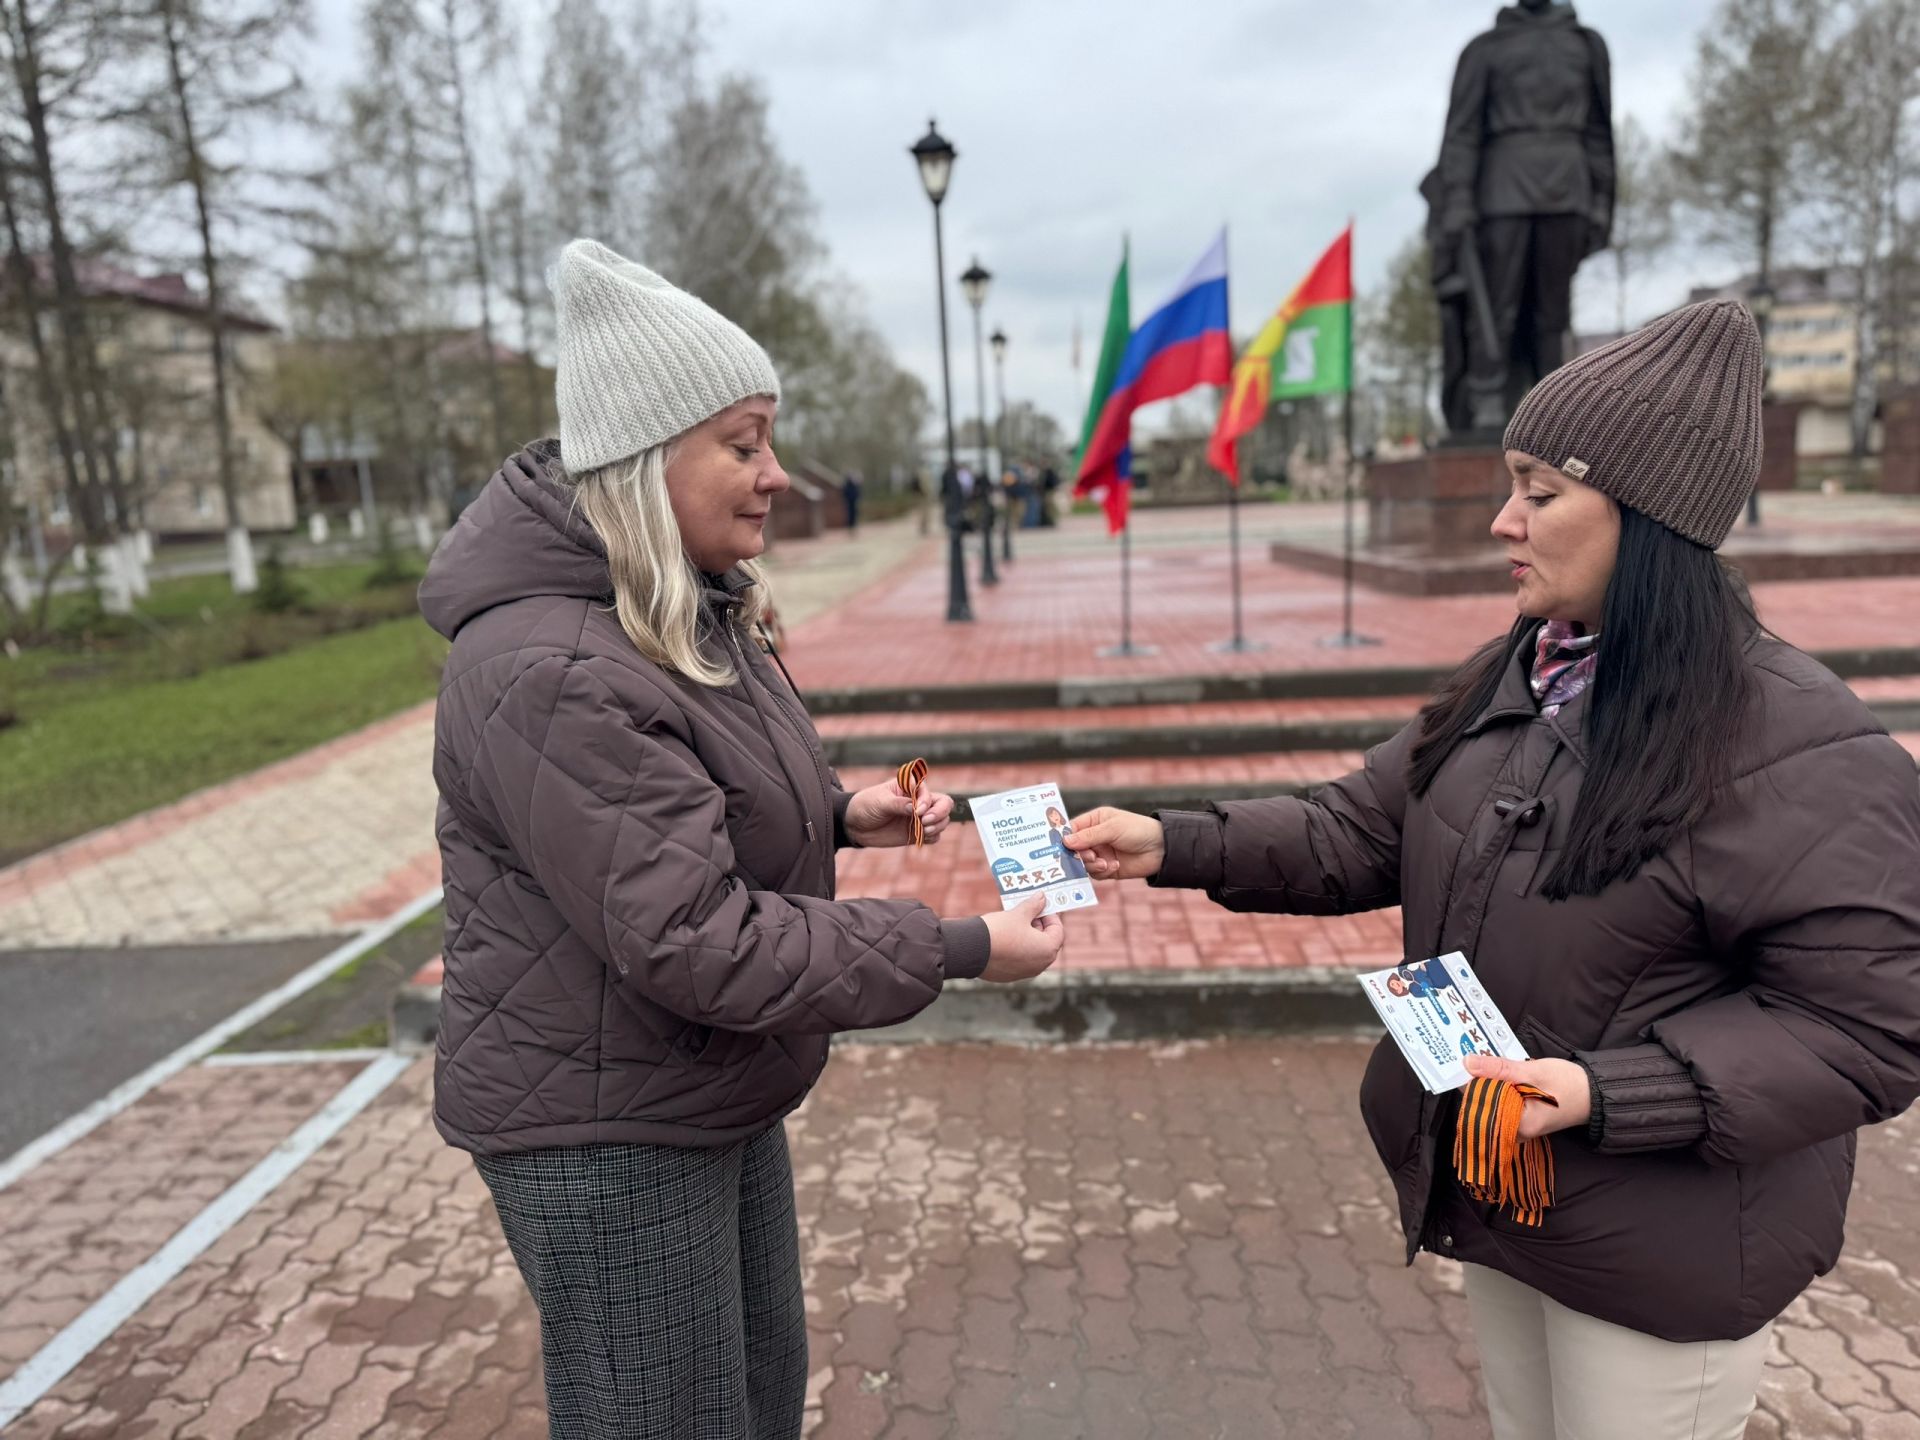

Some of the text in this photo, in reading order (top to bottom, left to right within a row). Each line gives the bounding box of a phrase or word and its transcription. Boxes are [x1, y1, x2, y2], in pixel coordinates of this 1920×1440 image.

[991, 816, 1023, 829] НОСИ
[994, 820, 1046, 836] ГЕОРГИЕВСКУЮ
[997, 834, 1018, 843] ЛЕНТУ
[1004, 833, 1046, 847] УВАЖЕНИЕМ
[1414, 1026, 1444, 1065] НОСИ
